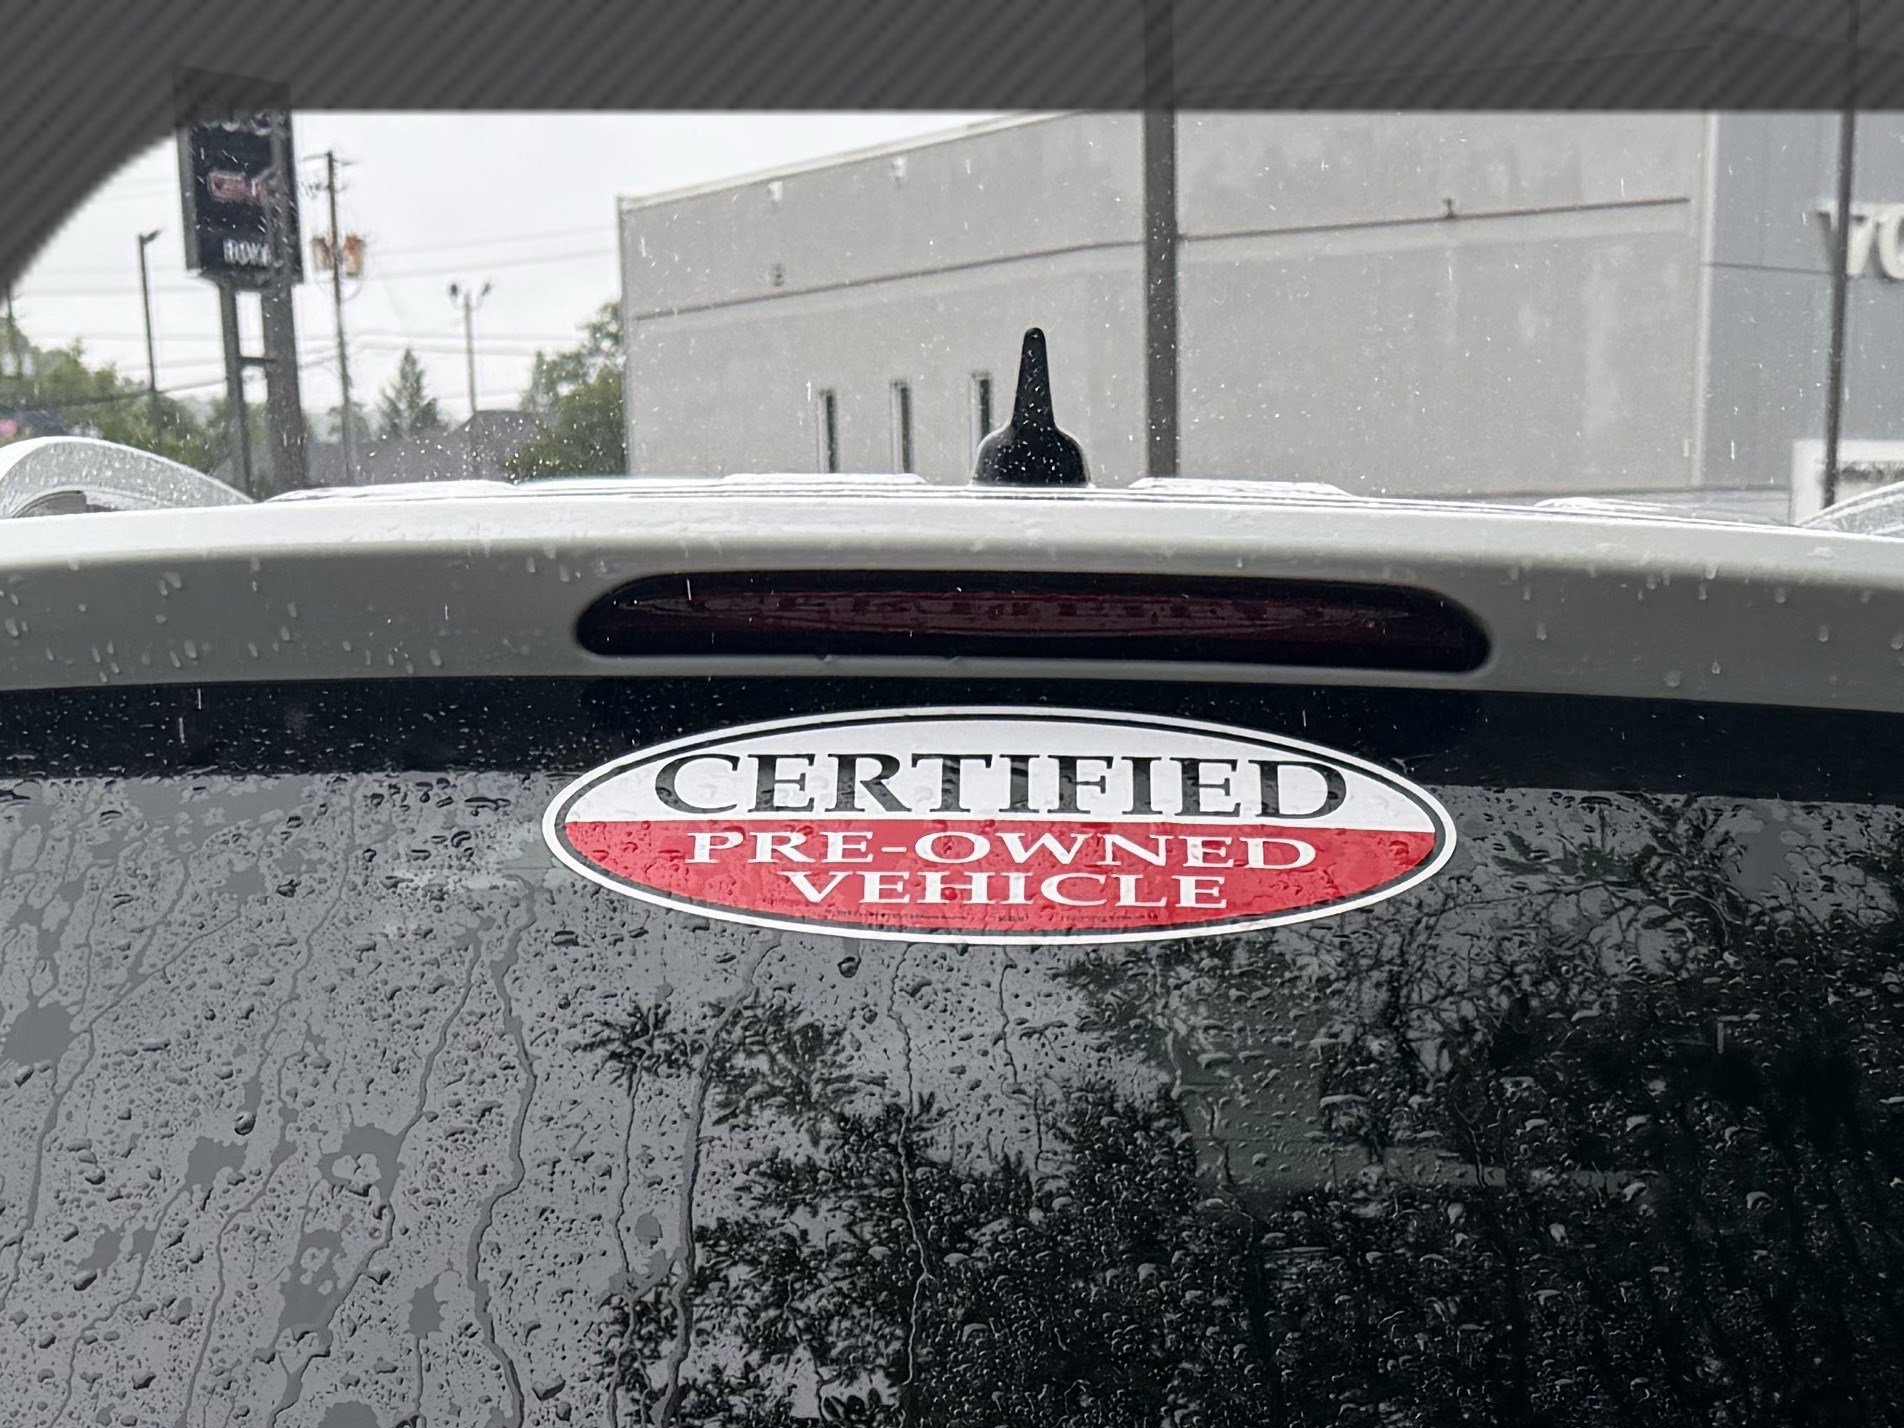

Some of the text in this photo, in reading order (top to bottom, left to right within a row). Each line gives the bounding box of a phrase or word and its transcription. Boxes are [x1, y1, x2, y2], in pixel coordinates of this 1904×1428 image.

[654, 752, 1348, 820] CERTIFIED
[685, 830, 1318, 870] PRE-OWNED
[777, 870, 1229, 909] VEHICLE
